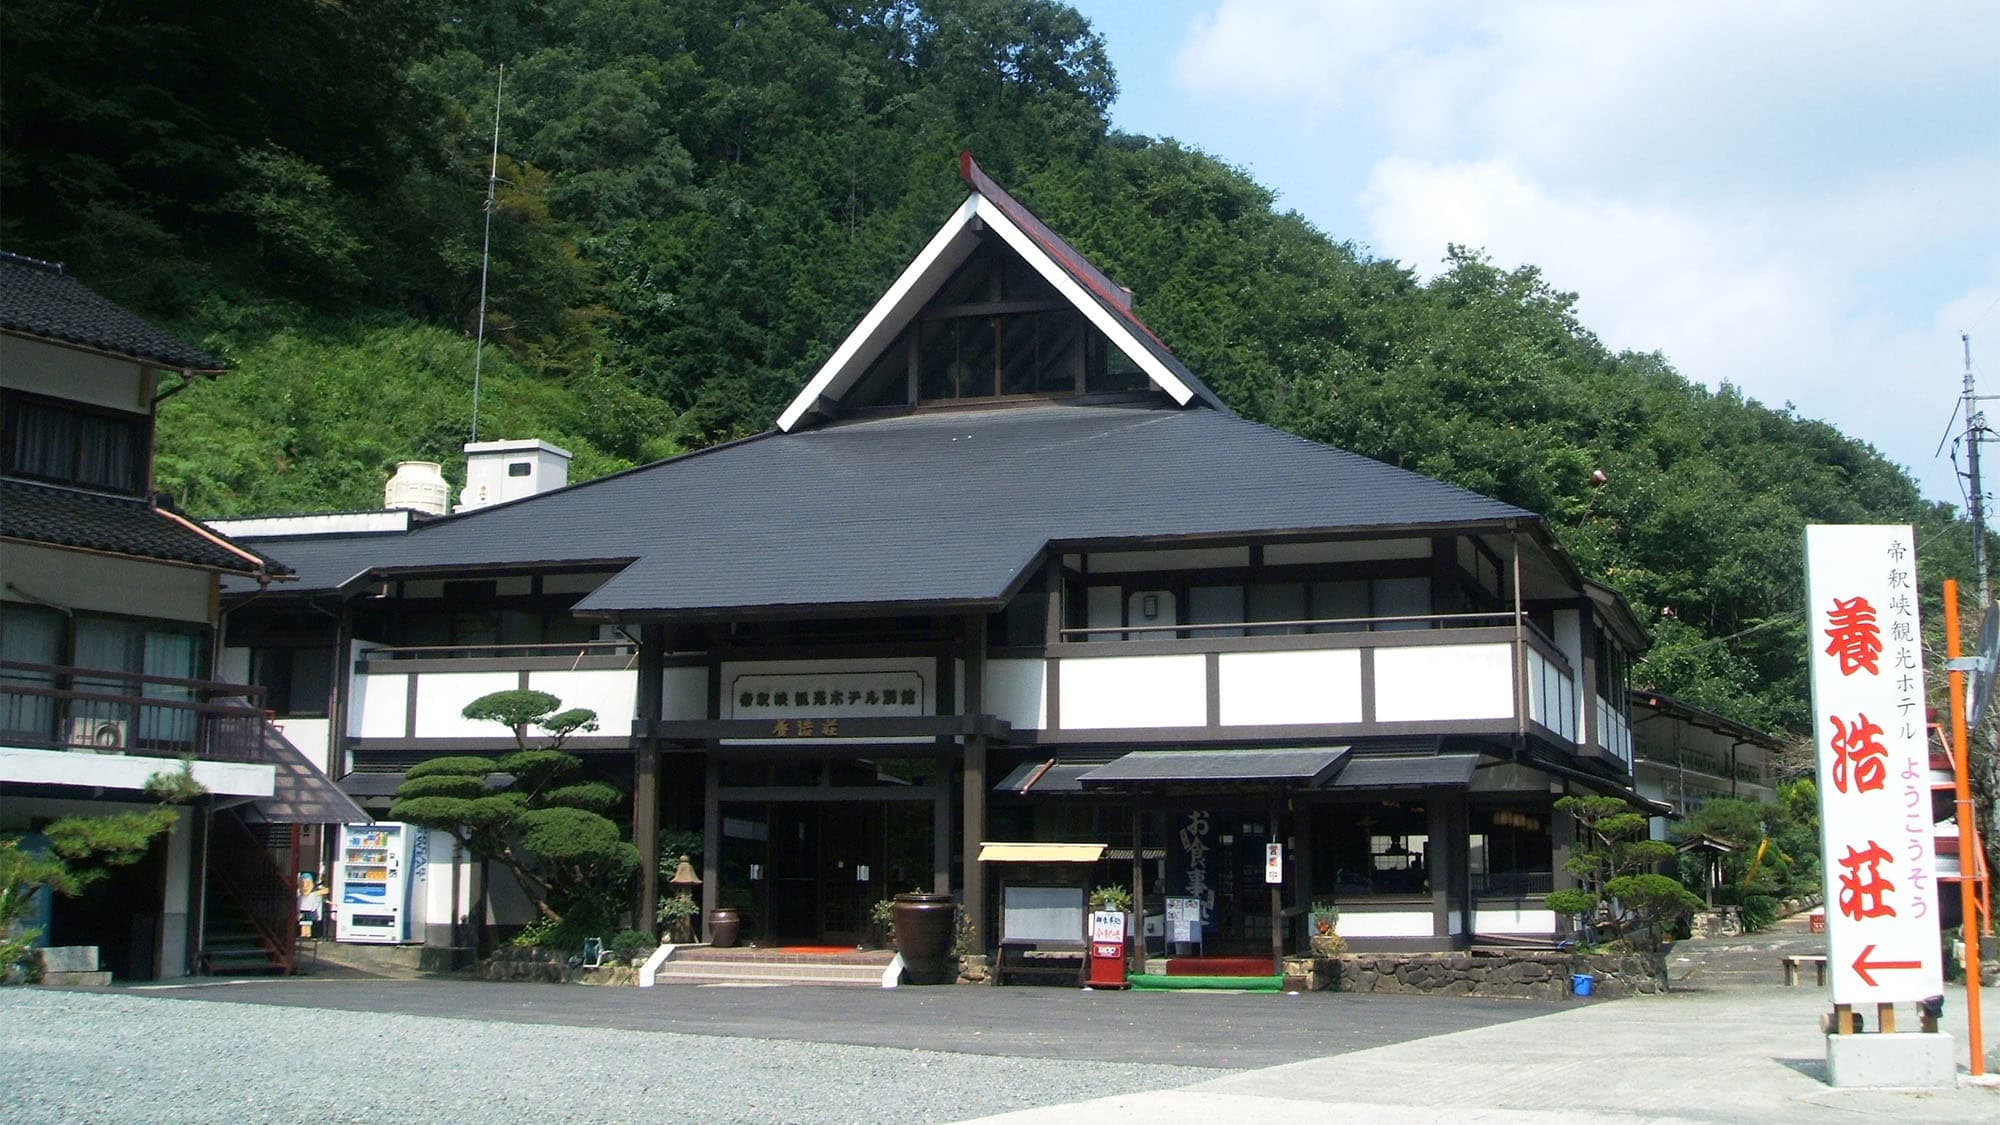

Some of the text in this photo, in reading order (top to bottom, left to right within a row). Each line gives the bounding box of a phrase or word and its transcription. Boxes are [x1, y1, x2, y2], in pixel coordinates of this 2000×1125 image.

[1824, 596, 1897, 922] 養浩荘
[1887, 540, 1917, 740] 帝釈峡観光ホテル
